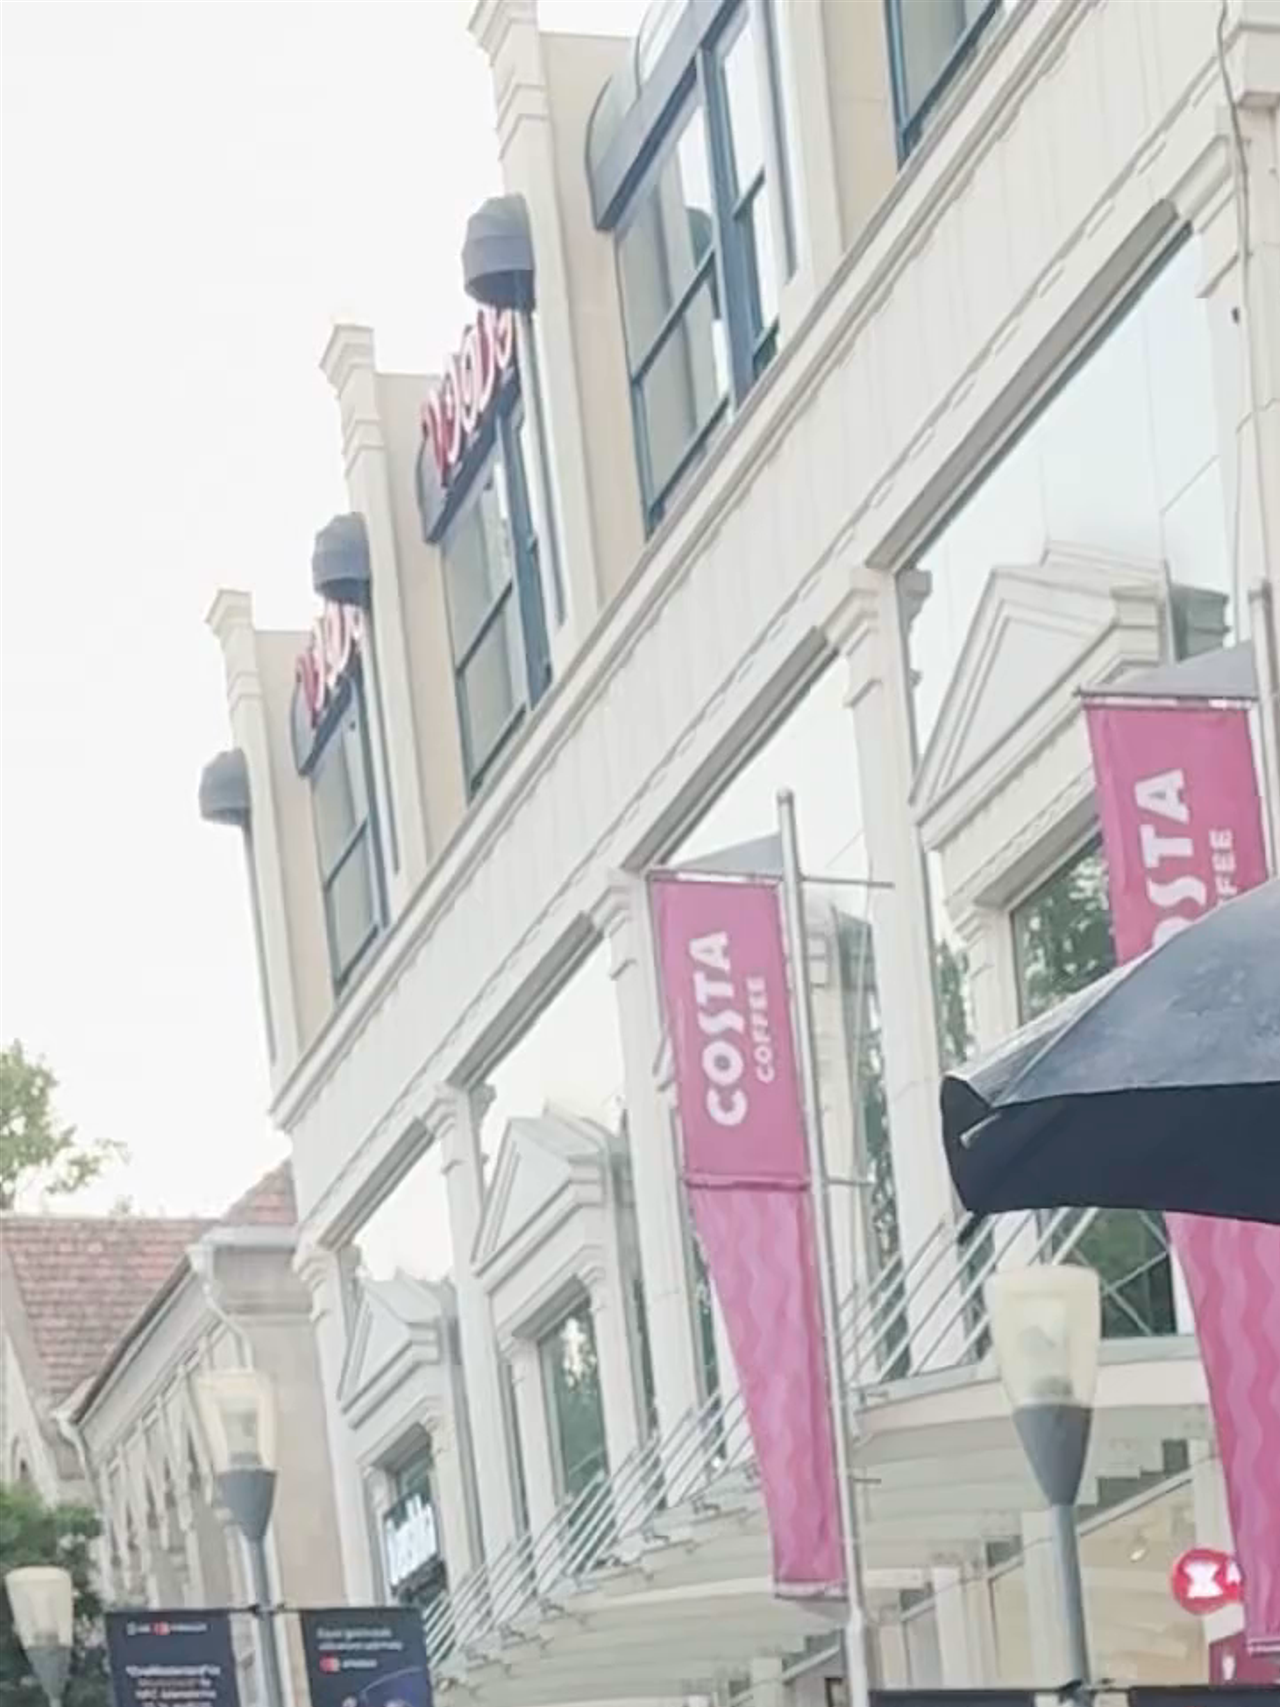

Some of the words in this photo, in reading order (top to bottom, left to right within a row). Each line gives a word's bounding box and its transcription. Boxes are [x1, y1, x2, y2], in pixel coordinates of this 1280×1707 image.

[1134, 769, 1208, 947] STA
[1209, 828, 1238, 902] FEE
[689, 931, 748, 1126] COSTA
[746, 976, 775, 1083] COFFEE
